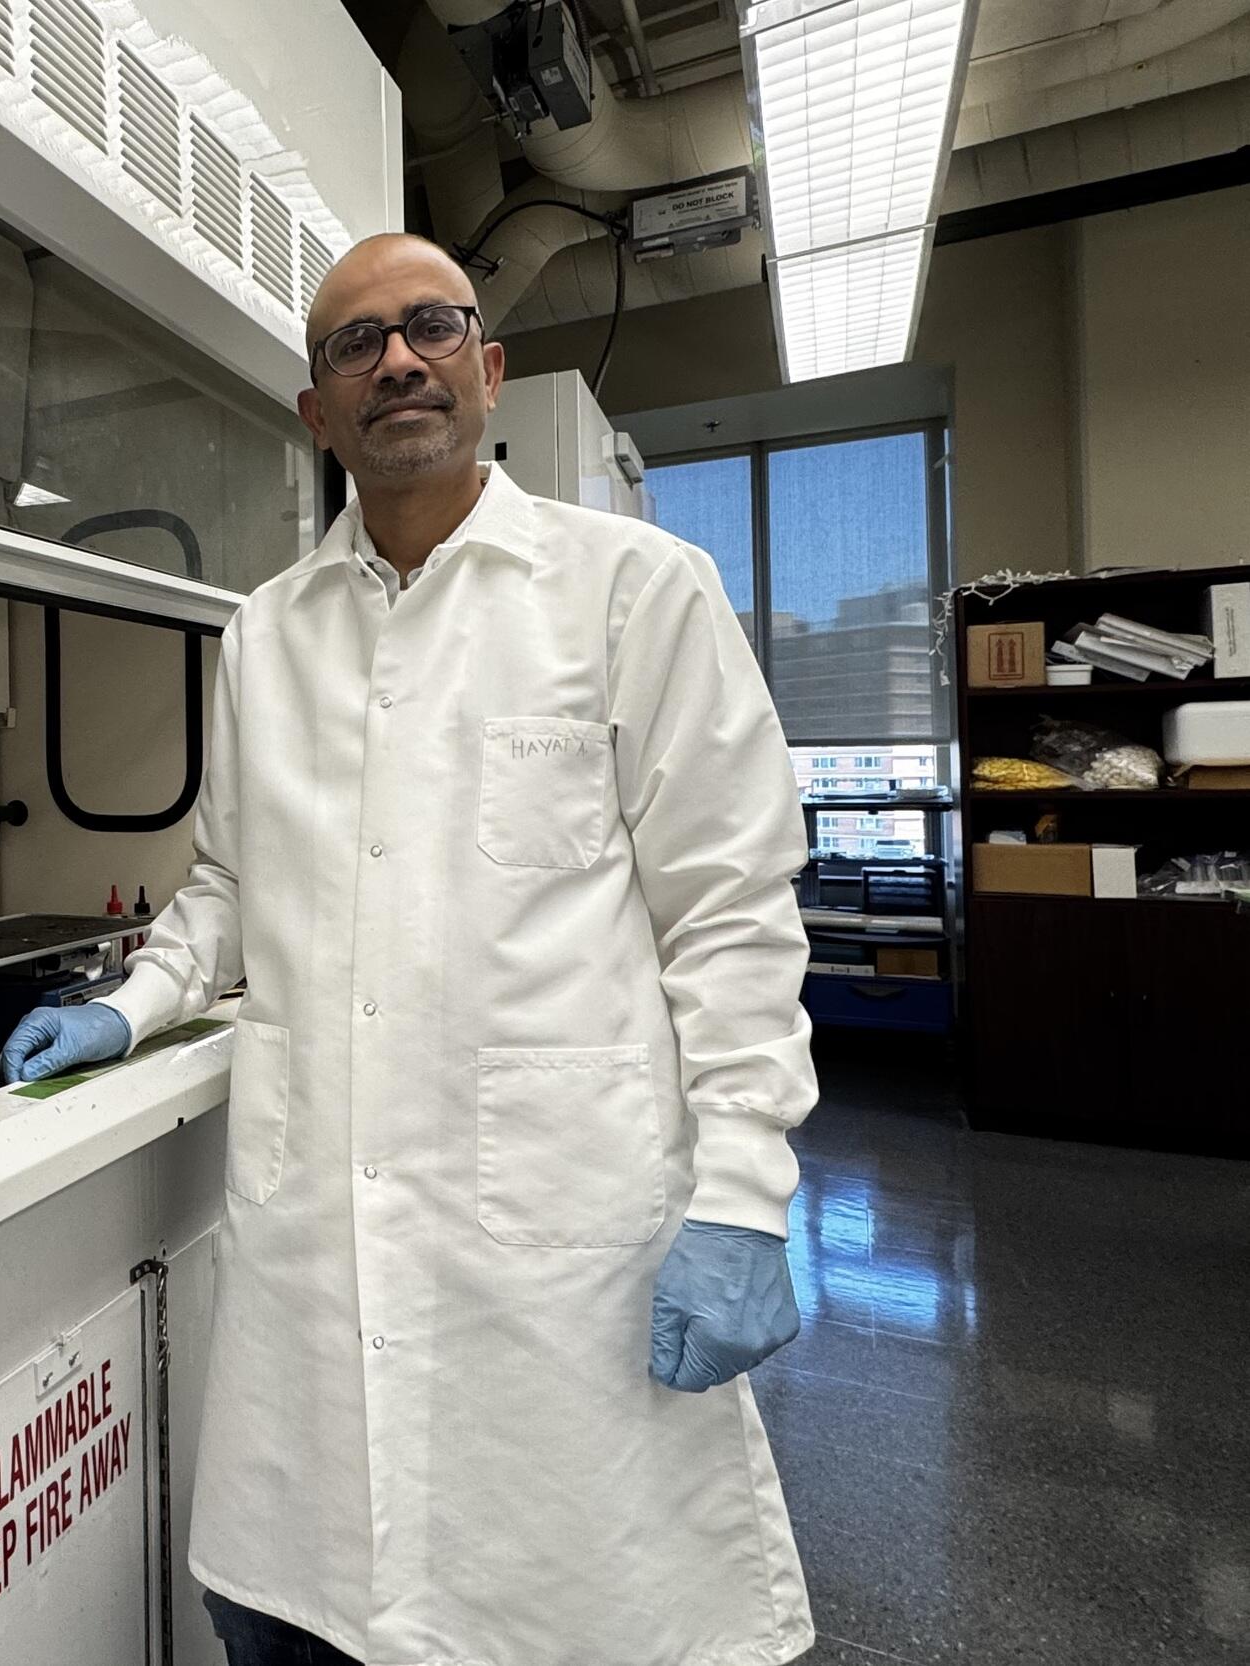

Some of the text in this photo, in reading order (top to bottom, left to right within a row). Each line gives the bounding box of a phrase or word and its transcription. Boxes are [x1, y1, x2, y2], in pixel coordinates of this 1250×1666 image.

[672, 203, 685, 211] DO
[686, 199, 703, 208] NOT
[705, 191, 735, 205] BLOCK
[512, 738, 572, 759] HAYAT
[25, 1467, 72, 1566] FIRE
[80, 1412, 131, 1515] AWAY
